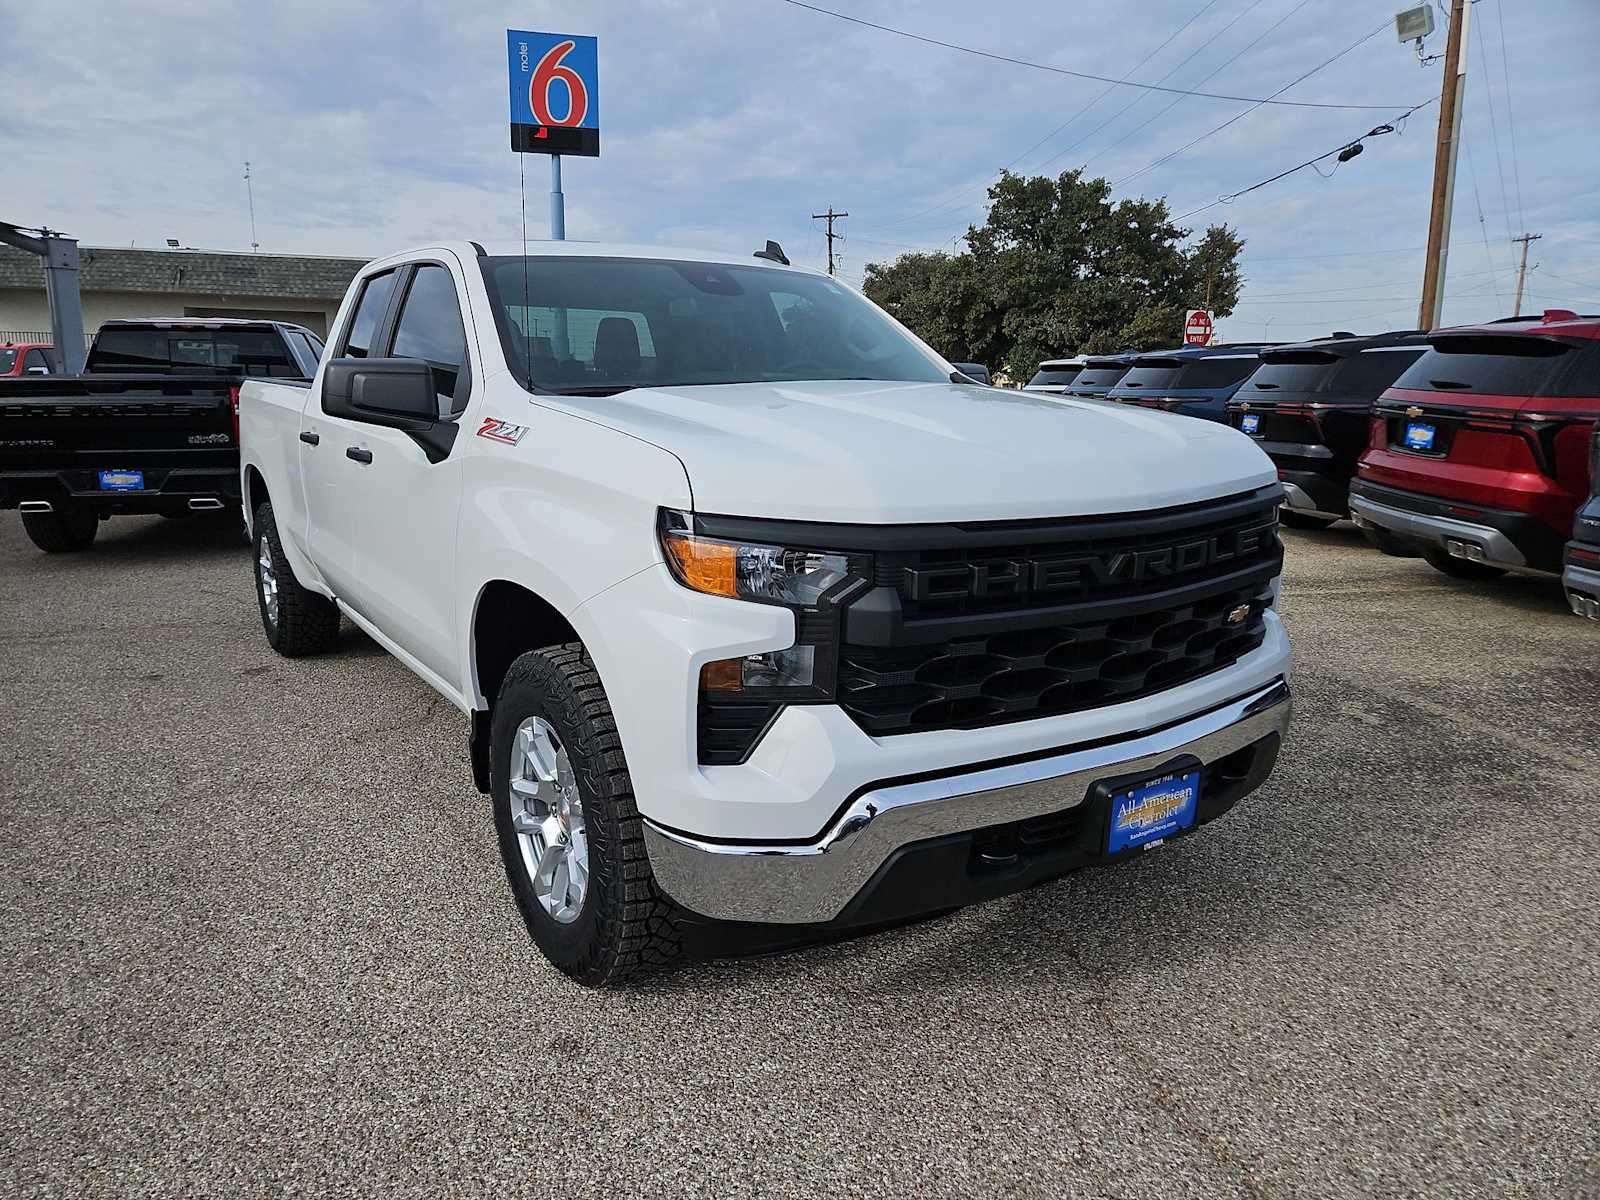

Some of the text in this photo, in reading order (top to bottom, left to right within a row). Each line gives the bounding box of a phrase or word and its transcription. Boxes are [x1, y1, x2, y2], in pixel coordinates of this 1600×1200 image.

[519, 42, 528, 72] motel
[529, 40, 588, 127] 6
[476, 417, 530, 446] Z71
[1117, 787, 1192, 818] All American
[1128, 804, 1179, 830] Chevrolet
